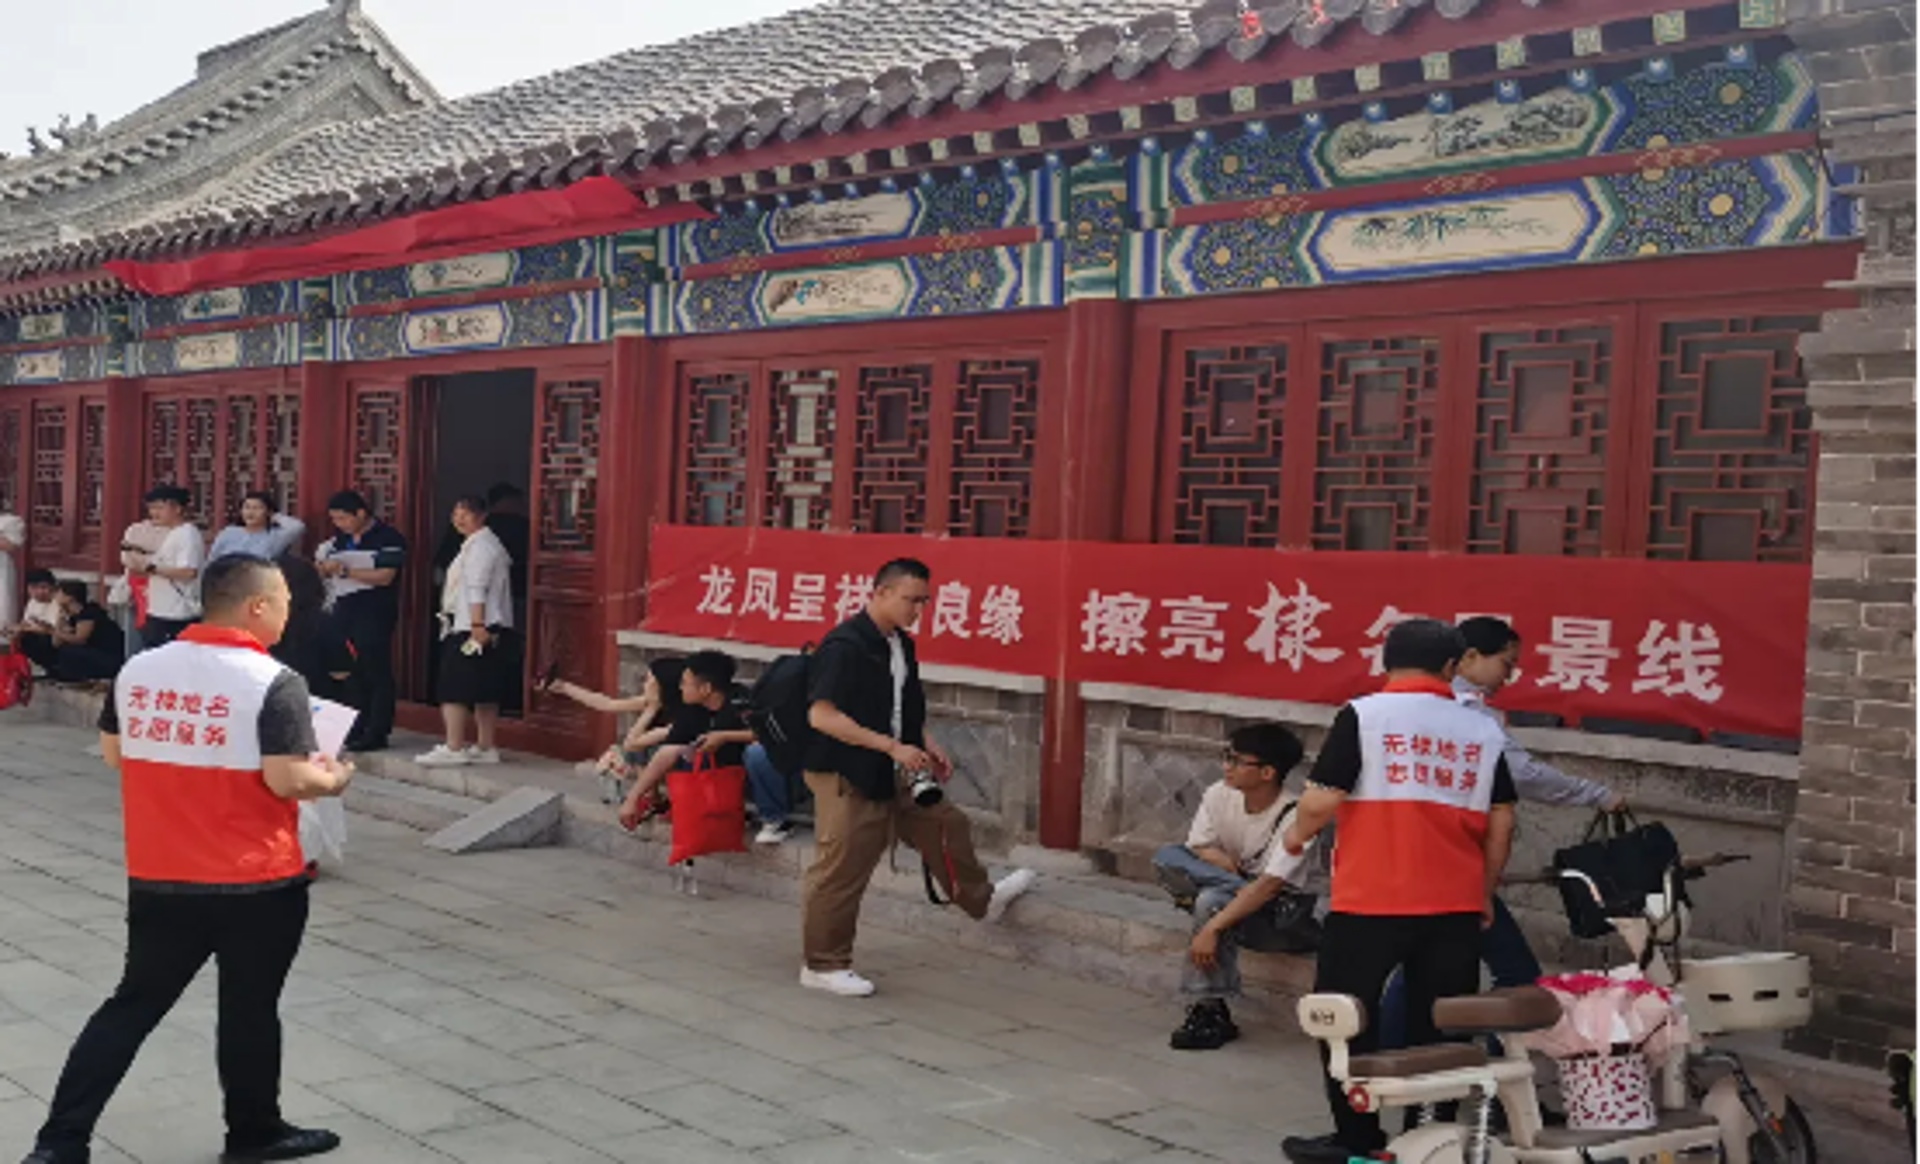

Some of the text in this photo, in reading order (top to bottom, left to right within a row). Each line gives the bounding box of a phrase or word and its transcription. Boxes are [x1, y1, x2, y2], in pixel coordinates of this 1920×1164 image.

[696, 565, 1723, 703] 龙凤呈祥良缘 擦亮棣景线
